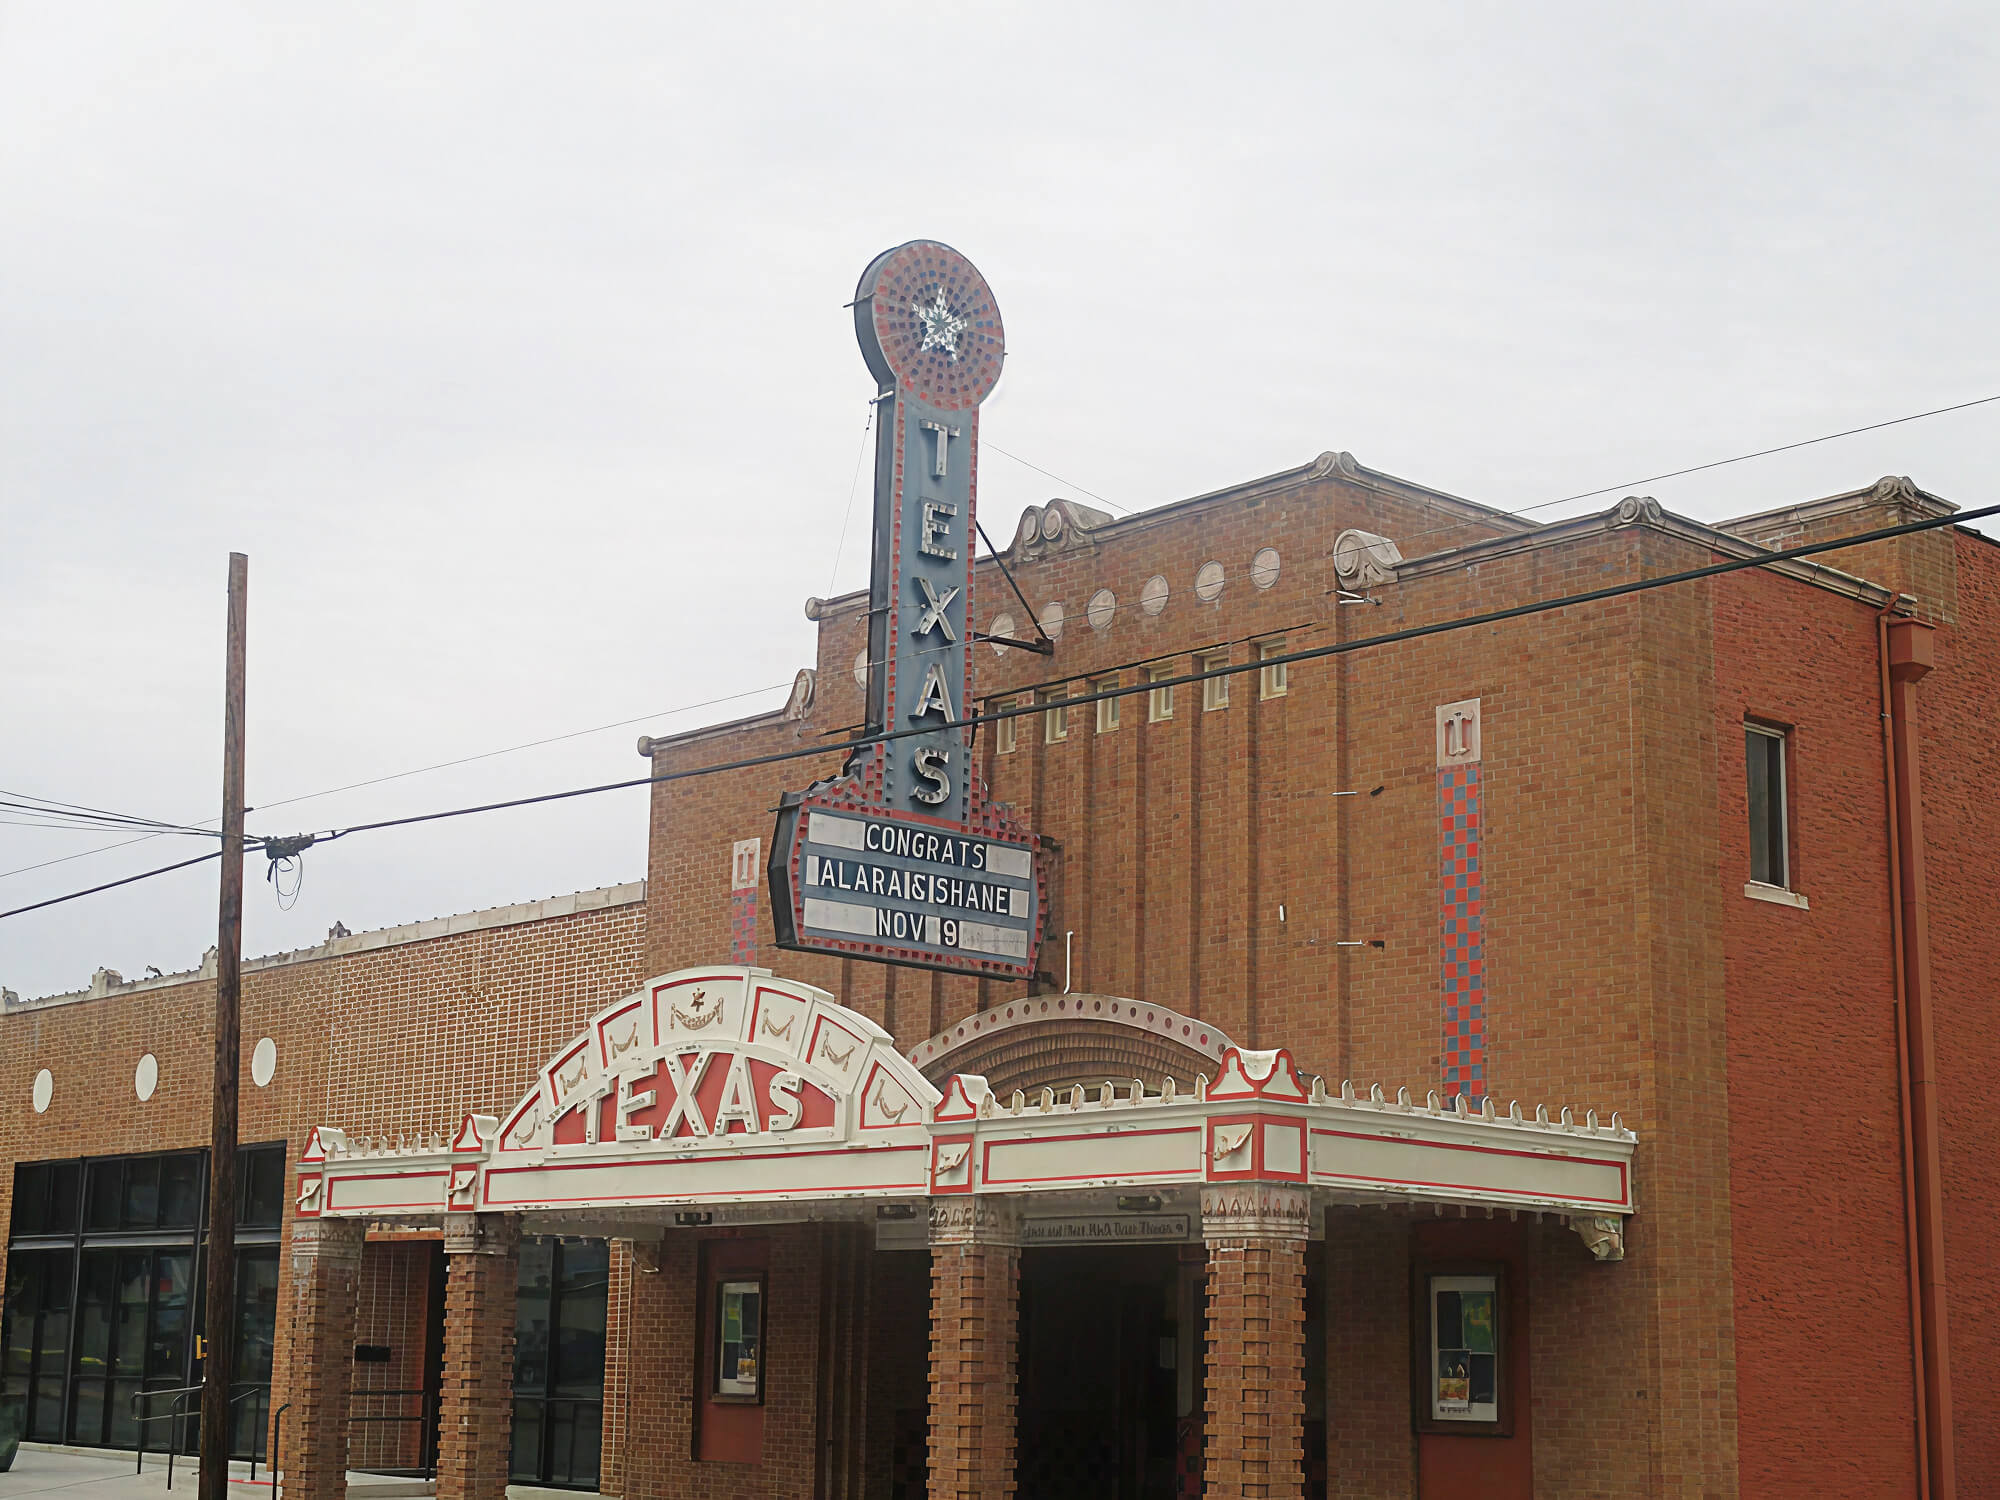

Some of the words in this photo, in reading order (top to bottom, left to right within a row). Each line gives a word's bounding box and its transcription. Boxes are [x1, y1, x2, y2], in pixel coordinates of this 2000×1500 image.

[908, 418, 962, 804] TEXAS
[866, 823, 986, 869] CONGRATS
[877, 909, 925, 943] NOV
[942, 920, 959, 947] 9
[574, 1051, 804, 1144] TEXAS
